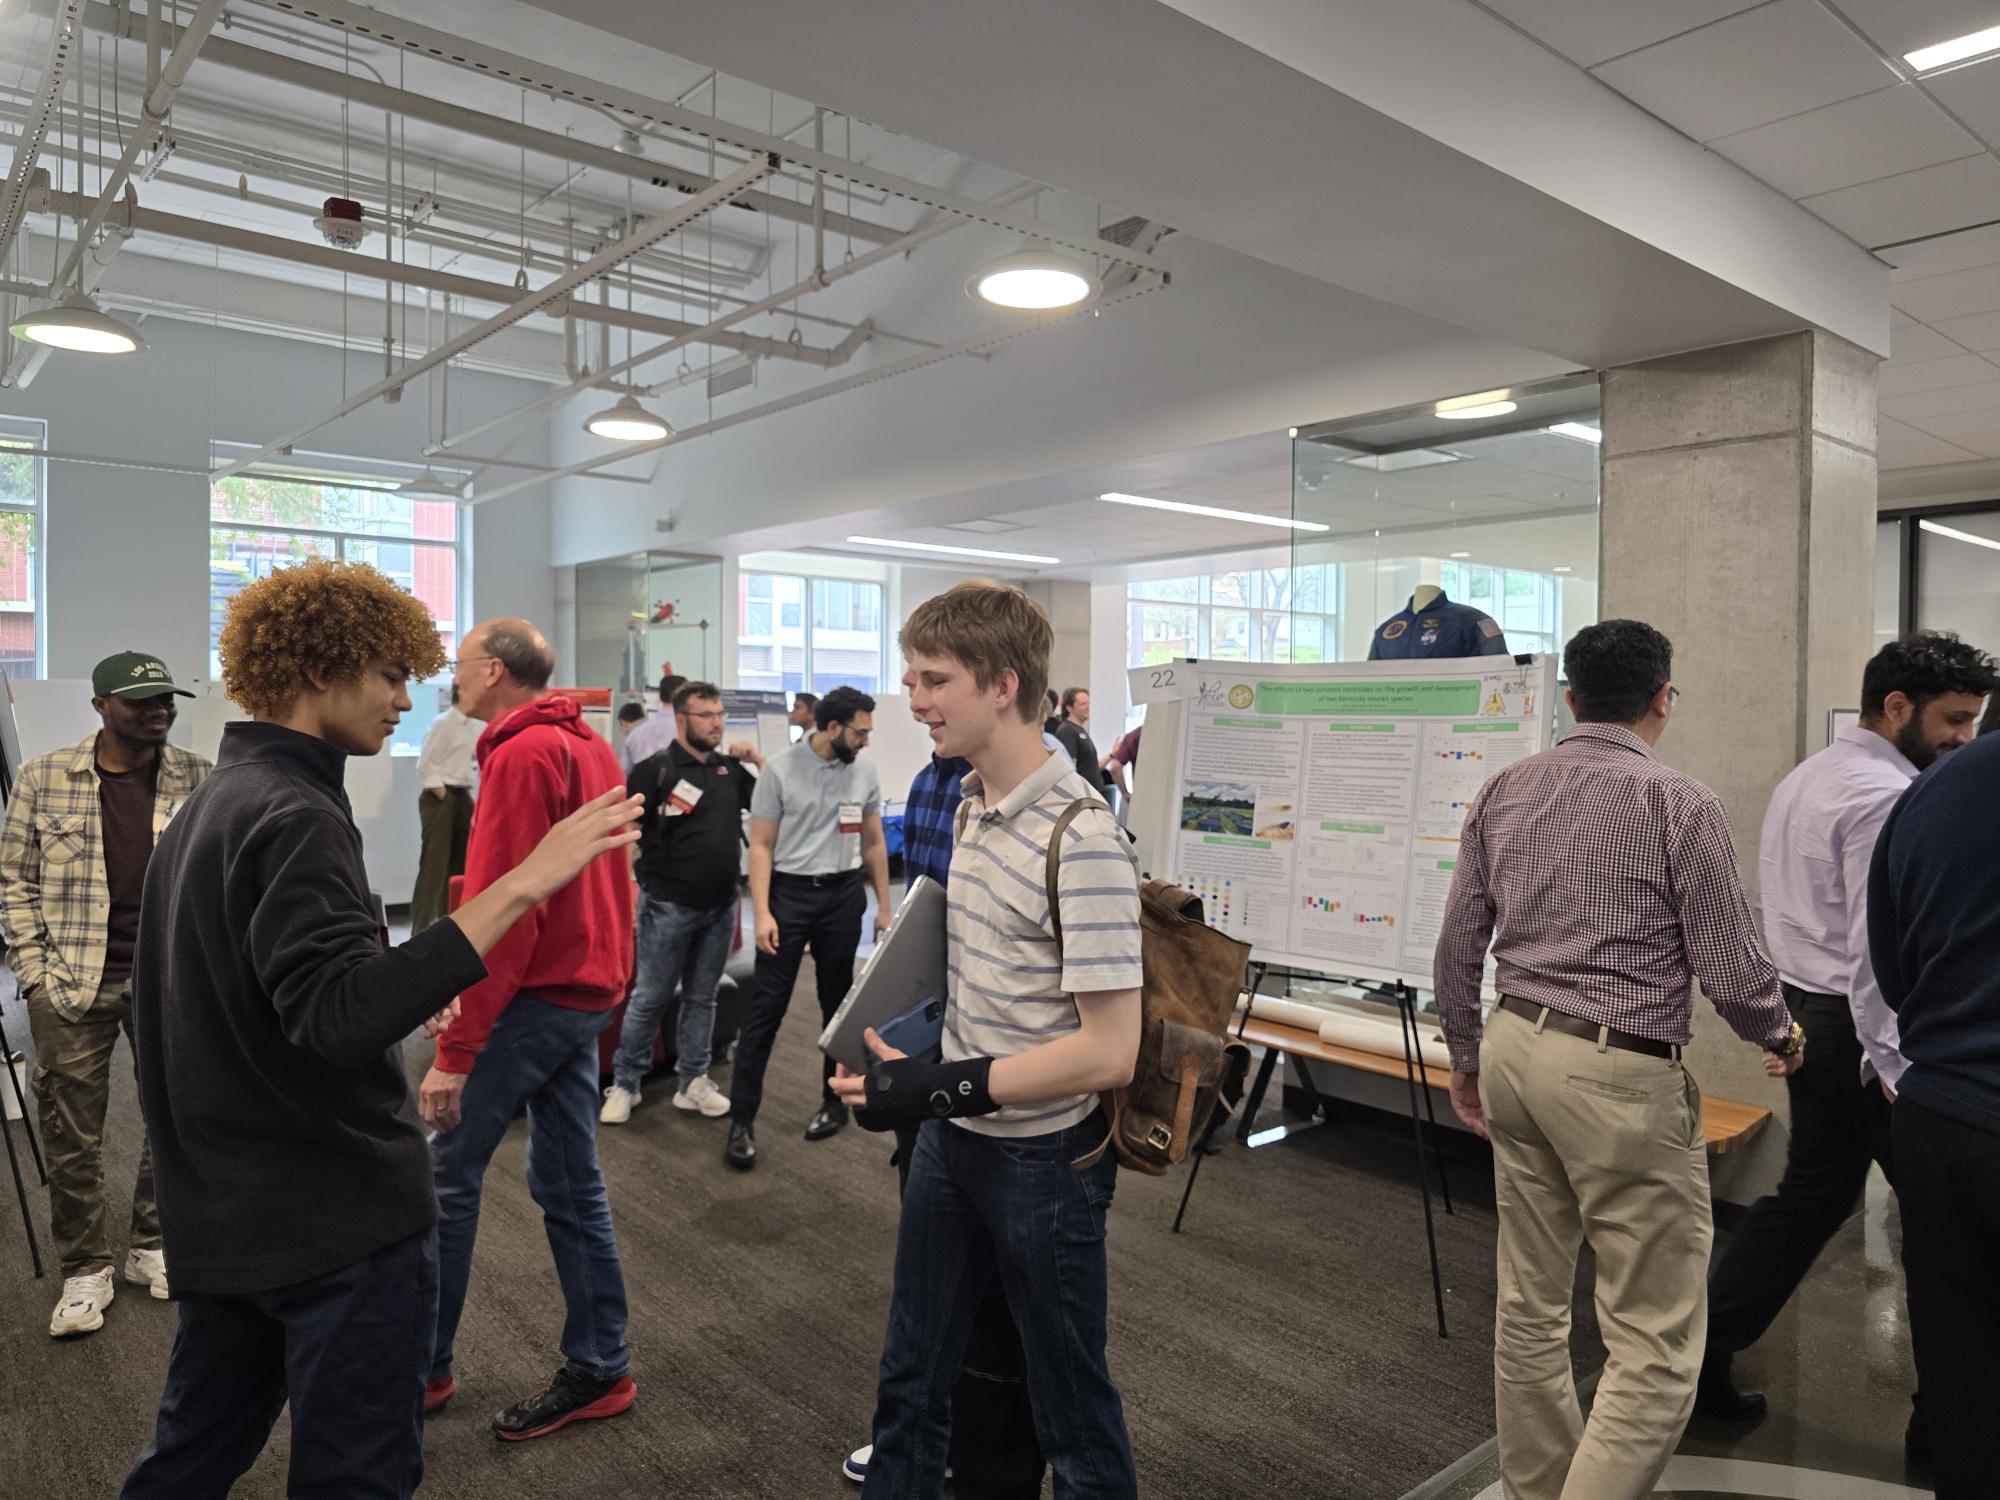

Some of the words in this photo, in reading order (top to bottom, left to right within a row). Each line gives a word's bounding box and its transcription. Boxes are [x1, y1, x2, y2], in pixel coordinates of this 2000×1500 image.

[131, 665, 145, 677] LOS
[1150, 669, 1175, 689] 22
[958, 1080, 973, 1095] e
